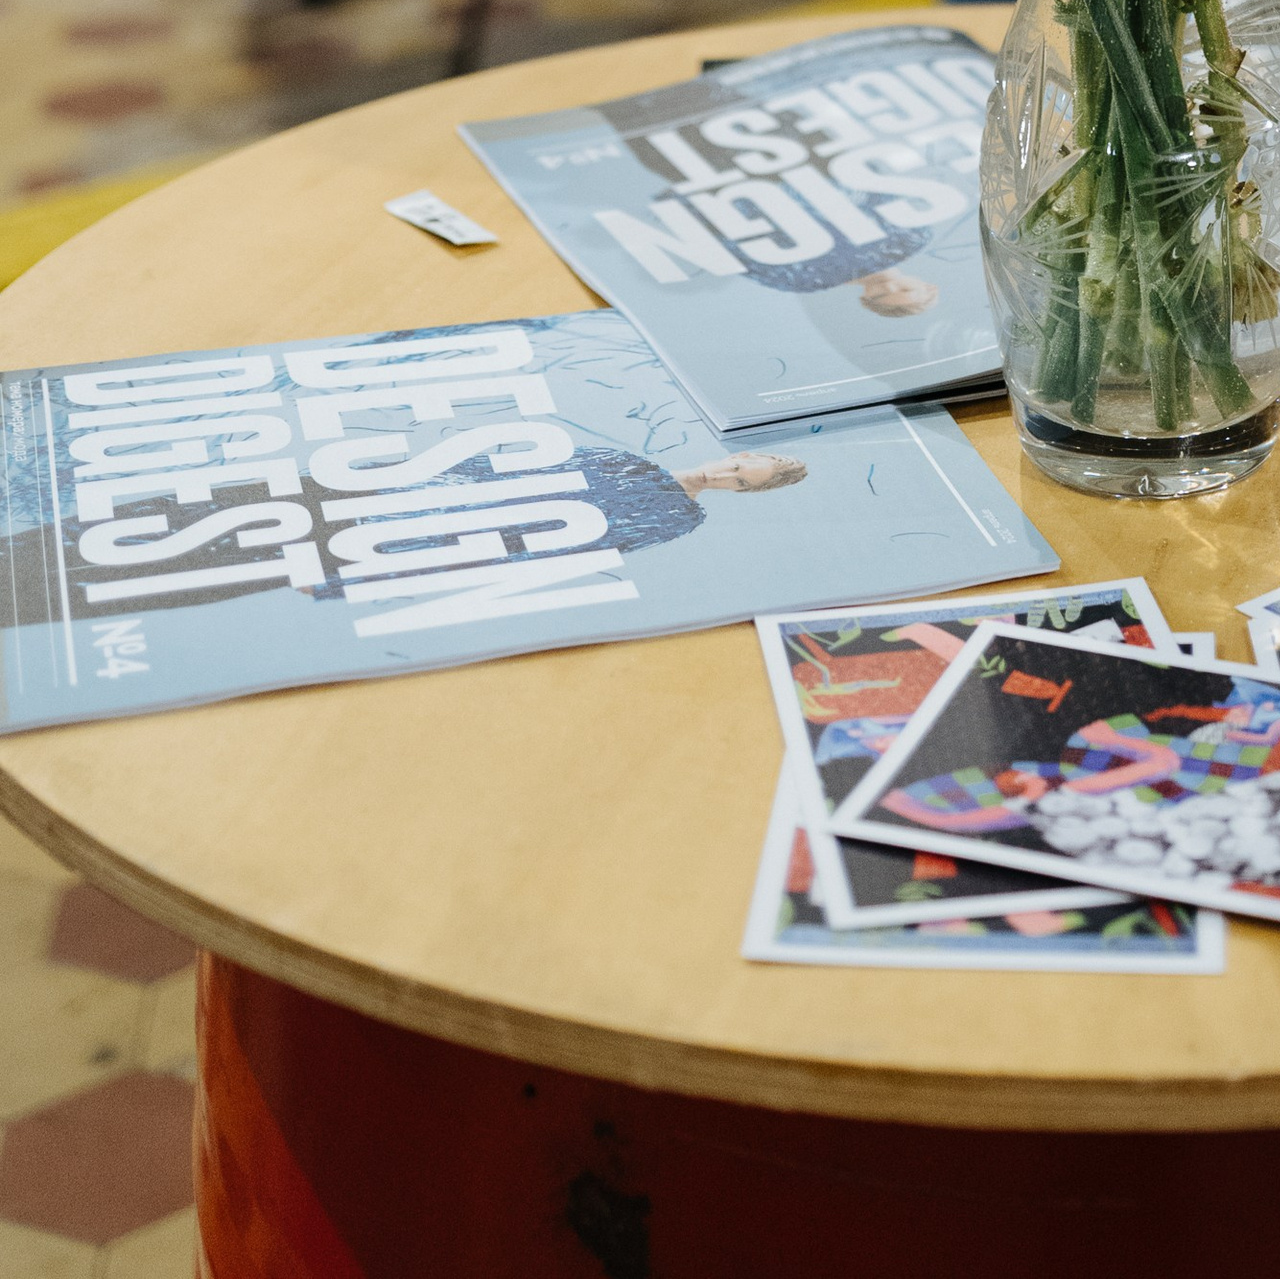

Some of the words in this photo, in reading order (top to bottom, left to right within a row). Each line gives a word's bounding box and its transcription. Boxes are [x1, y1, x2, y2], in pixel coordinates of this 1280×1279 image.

[594, 120, 984, 284] ESIGN
[63, 354, 327, 603] DIGEST
[283, 328, 640, 638] DESIGN
[91, 618, 150, 679] №4
